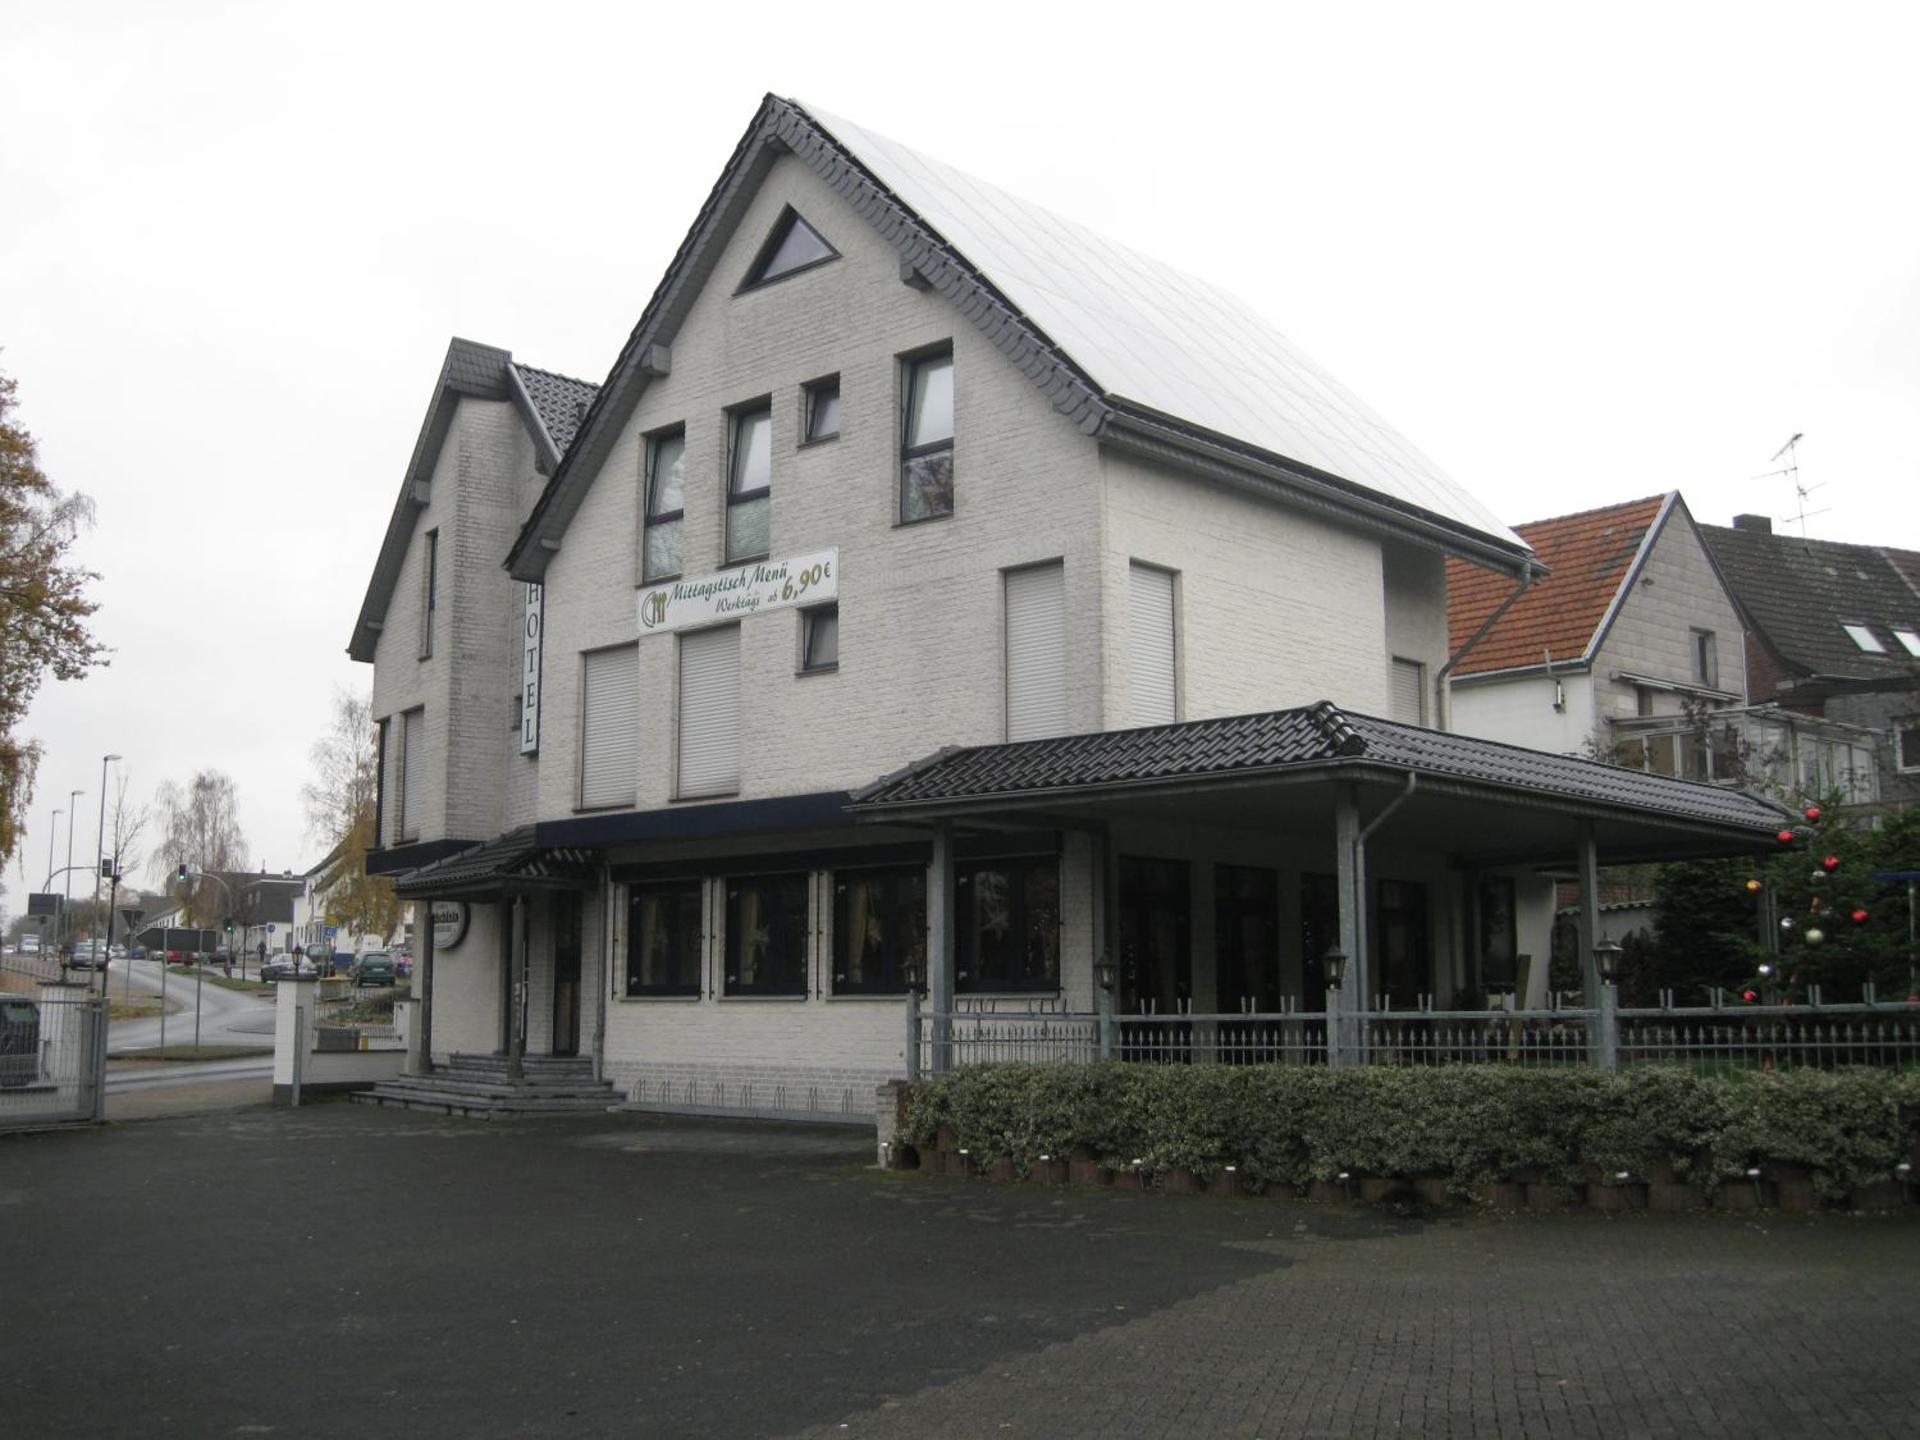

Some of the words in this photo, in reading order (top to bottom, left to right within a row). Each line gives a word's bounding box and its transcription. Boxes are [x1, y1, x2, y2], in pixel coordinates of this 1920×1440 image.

[667, 568, 746, 608] Mittagstisch
[749, 562, 787, 589] Menü
[768, 589, 777, 604] ab
[525, 583, 539, 743] HOTEL
